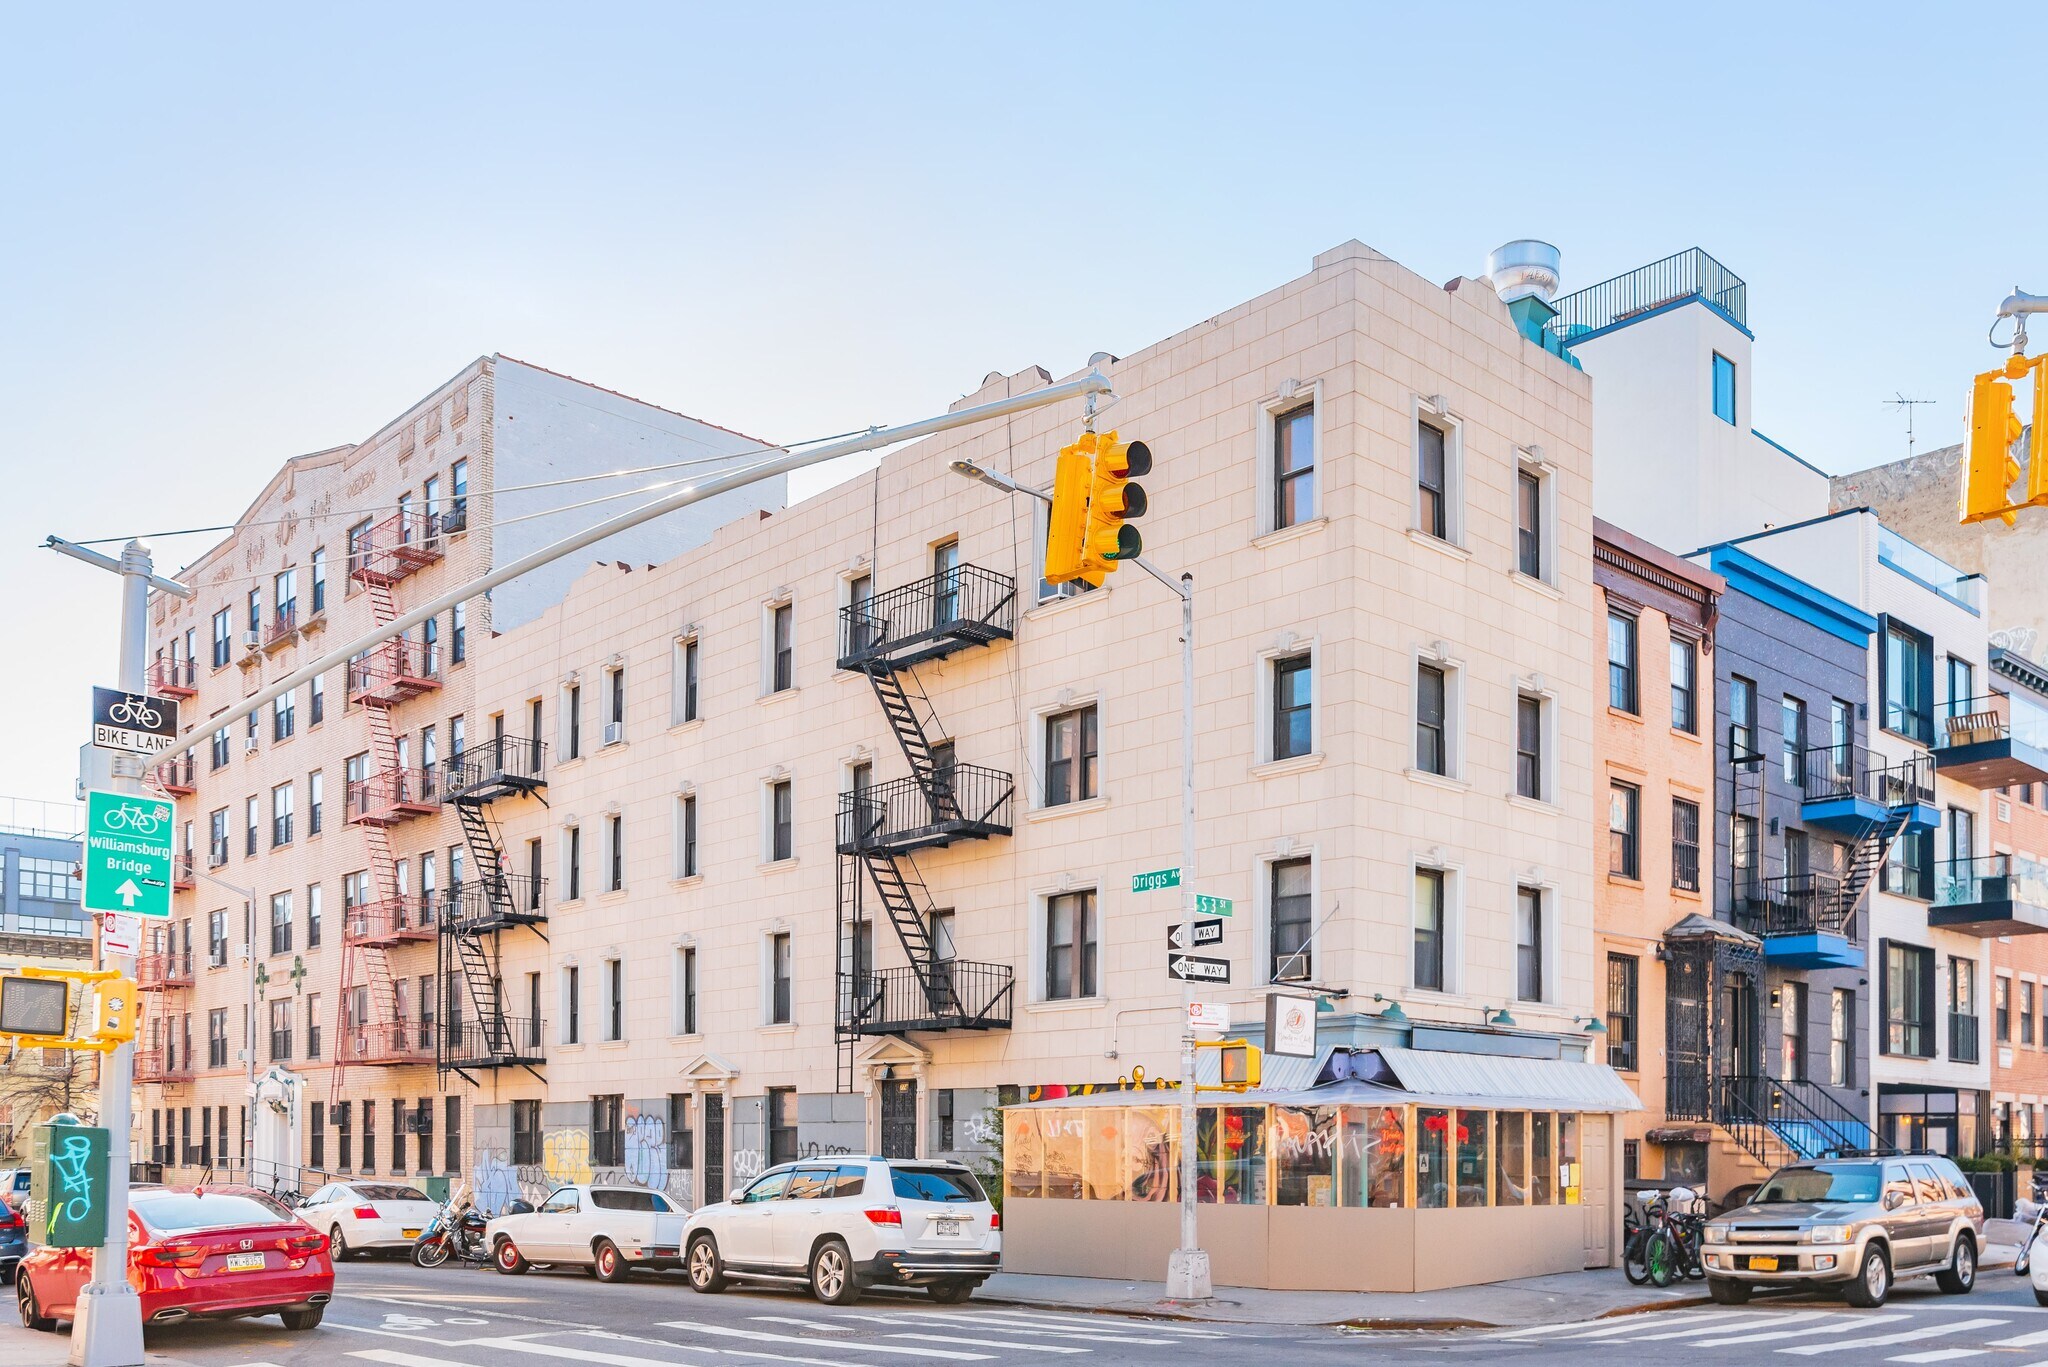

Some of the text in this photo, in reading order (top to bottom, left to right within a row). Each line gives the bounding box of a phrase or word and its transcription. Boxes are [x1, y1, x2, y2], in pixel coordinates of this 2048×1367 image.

[98, 727, 128, 746] BIKE
[89, 836, 170, 860] Williamsburg
[106, 857, 152, 876] Bridge
[1133, 873, 1167, 889] Driggs
[1201, 897, 1207, 912] S
[1210, 898, 1216, 913] 3
[1198, 926, 1215, 938] WAY
[1177, 962, 1222, 976] ONE WAY
[1420, 1156, 1427, 1167] A
